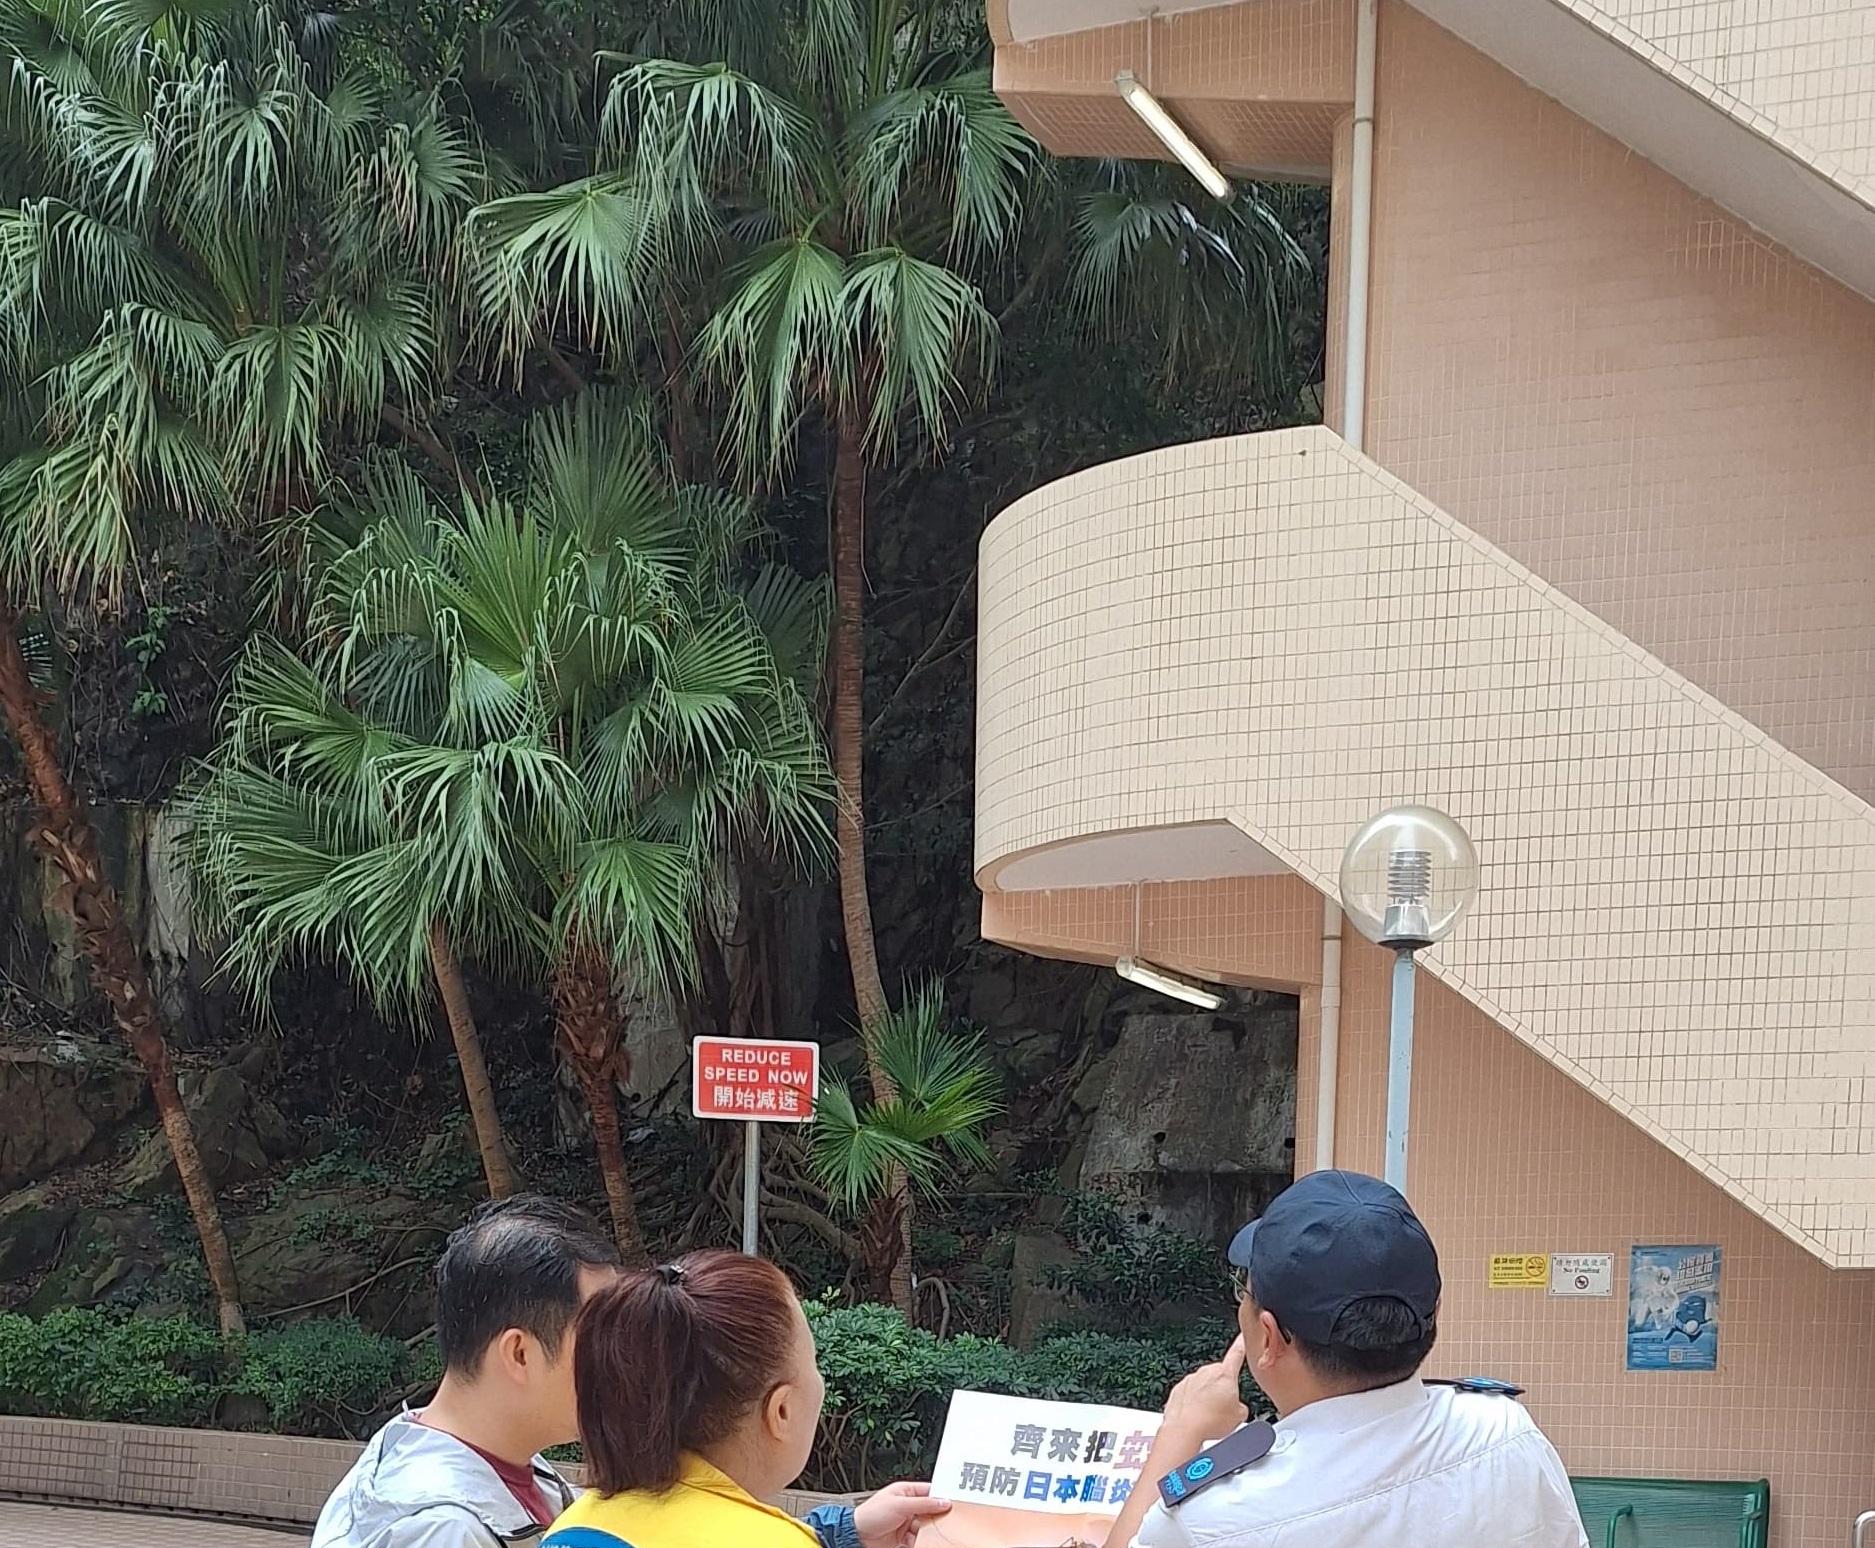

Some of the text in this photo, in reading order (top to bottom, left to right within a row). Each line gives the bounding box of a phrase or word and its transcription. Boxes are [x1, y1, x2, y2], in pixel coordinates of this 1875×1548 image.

[722, 1048, 791, 1066] REDUCE
[704, 1066, 808, 1085] SPEED NOW
[713, 1085, 799, 1111] 開始減速
